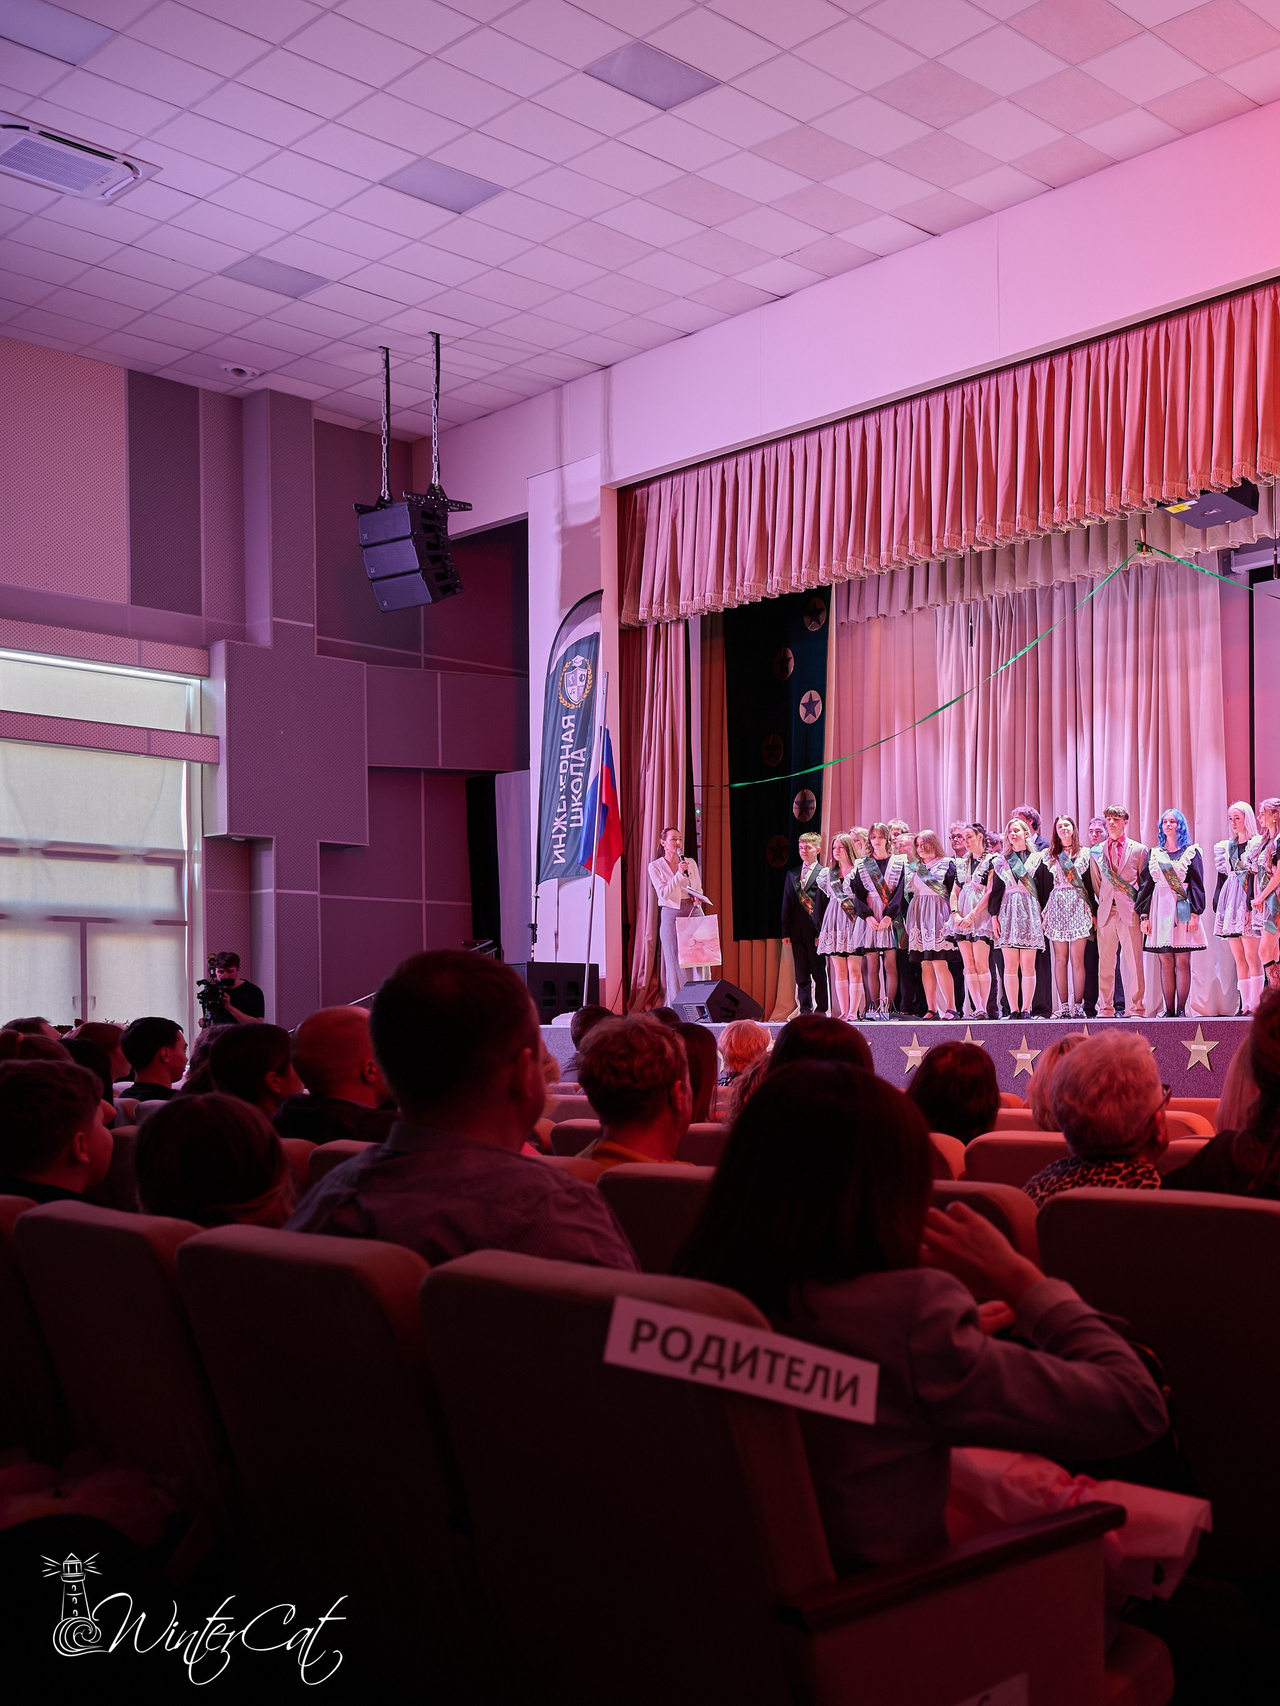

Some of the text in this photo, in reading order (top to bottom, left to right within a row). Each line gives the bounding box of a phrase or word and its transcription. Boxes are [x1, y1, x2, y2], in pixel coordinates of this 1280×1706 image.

[552, 714, 576, 865] ИНЖЕЕРНАЯ
[569, 746, 587, 828] ШКОЛА
[629, 1317, 860, 1407] РОДИТЕЛИ
